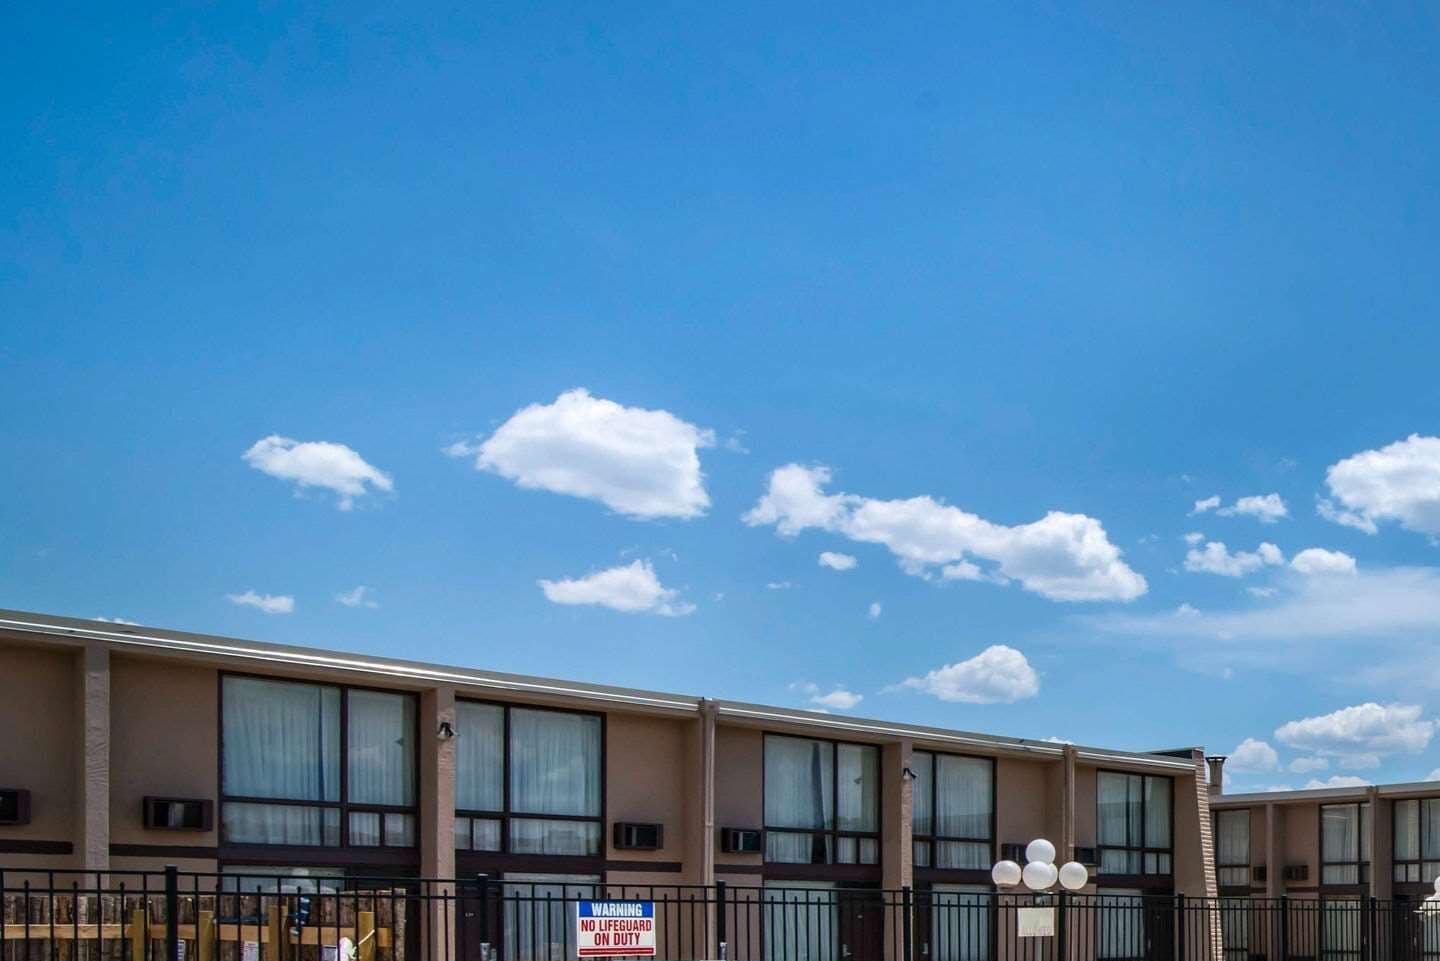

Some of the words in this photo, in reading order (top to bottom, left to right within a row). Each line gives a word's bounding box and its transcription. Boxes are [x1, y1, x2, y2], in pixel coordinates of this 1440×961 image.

[591, 902, 643, 917] WARNING
[581, 919, 596, 932] NO
[598, 919, 652, 932] LIFEGUARD
[594, 932, 610, 946] ON
[613, 932, 641, 946] DUTY
